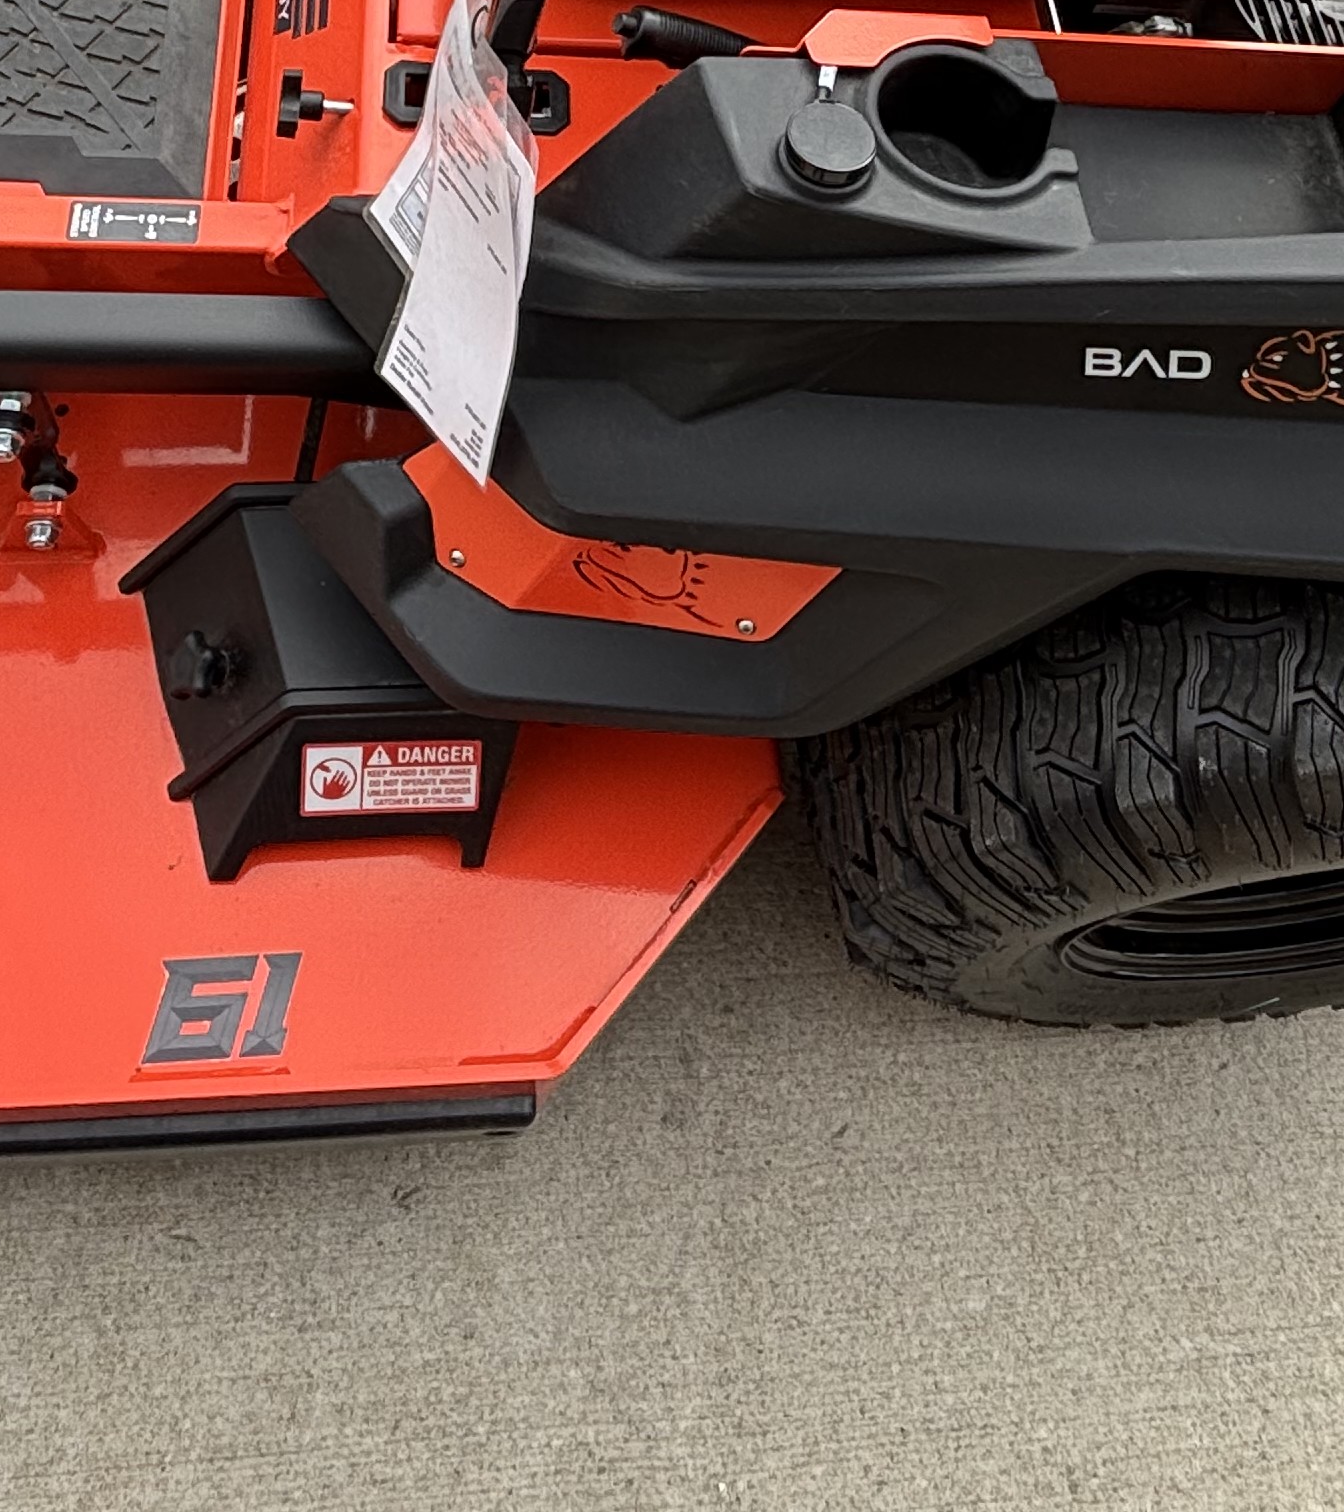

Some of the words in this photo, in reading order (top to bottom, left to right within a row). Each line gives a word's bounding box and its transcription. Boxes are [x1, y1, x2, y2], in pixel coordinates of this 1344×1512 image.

[1084, 347, 1212, 380] BAD
[397, 746, 474, 764] DANGER
[141, 952, 303, 1065] 61
